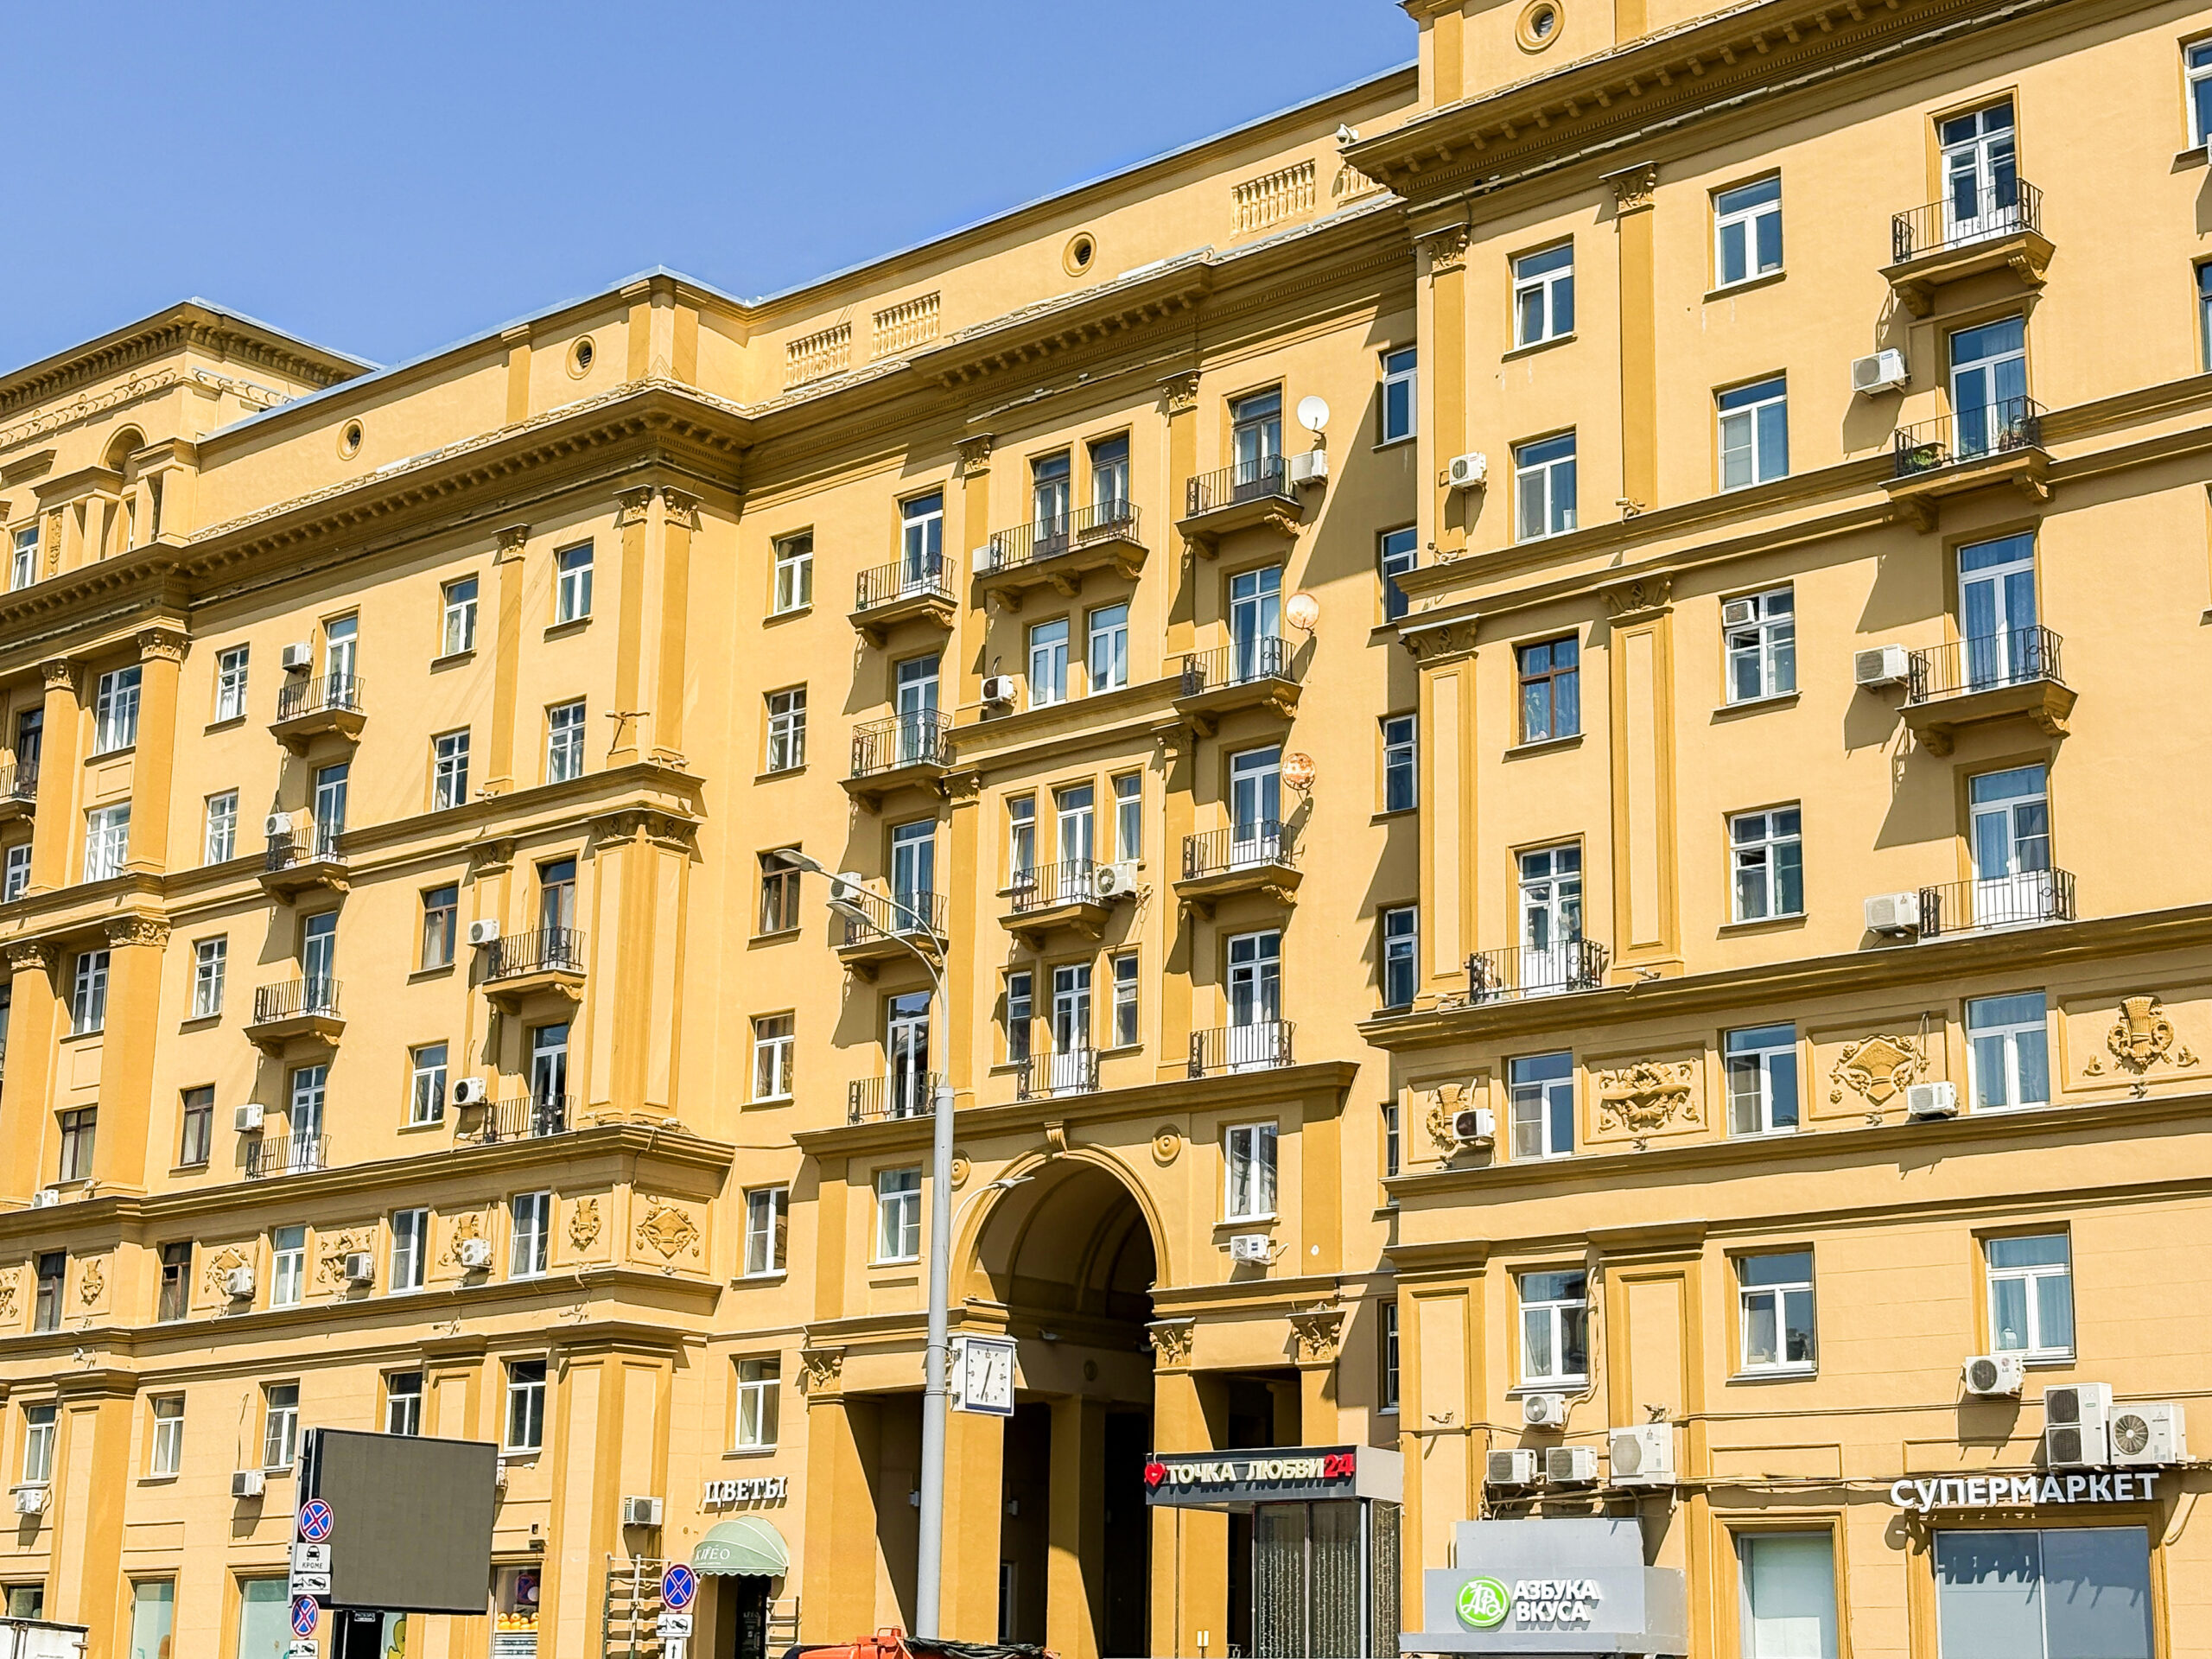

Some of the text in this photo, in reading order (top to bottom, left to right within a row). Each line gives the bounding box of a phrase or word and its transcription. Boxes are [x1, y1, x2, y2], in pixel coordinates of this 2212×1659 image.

[1166, 1461, 1237, 1484] ТОЧКА
[703, 1476, 787, 1509] ЦВЕТЫ
[1890, 1472, 2159, 1513] СУПЕРМАРКЕТ
[1513, 1579, 1601, 1600] АЗБУКА
[1515, 1600, 1592, 1622] ВКУСА
